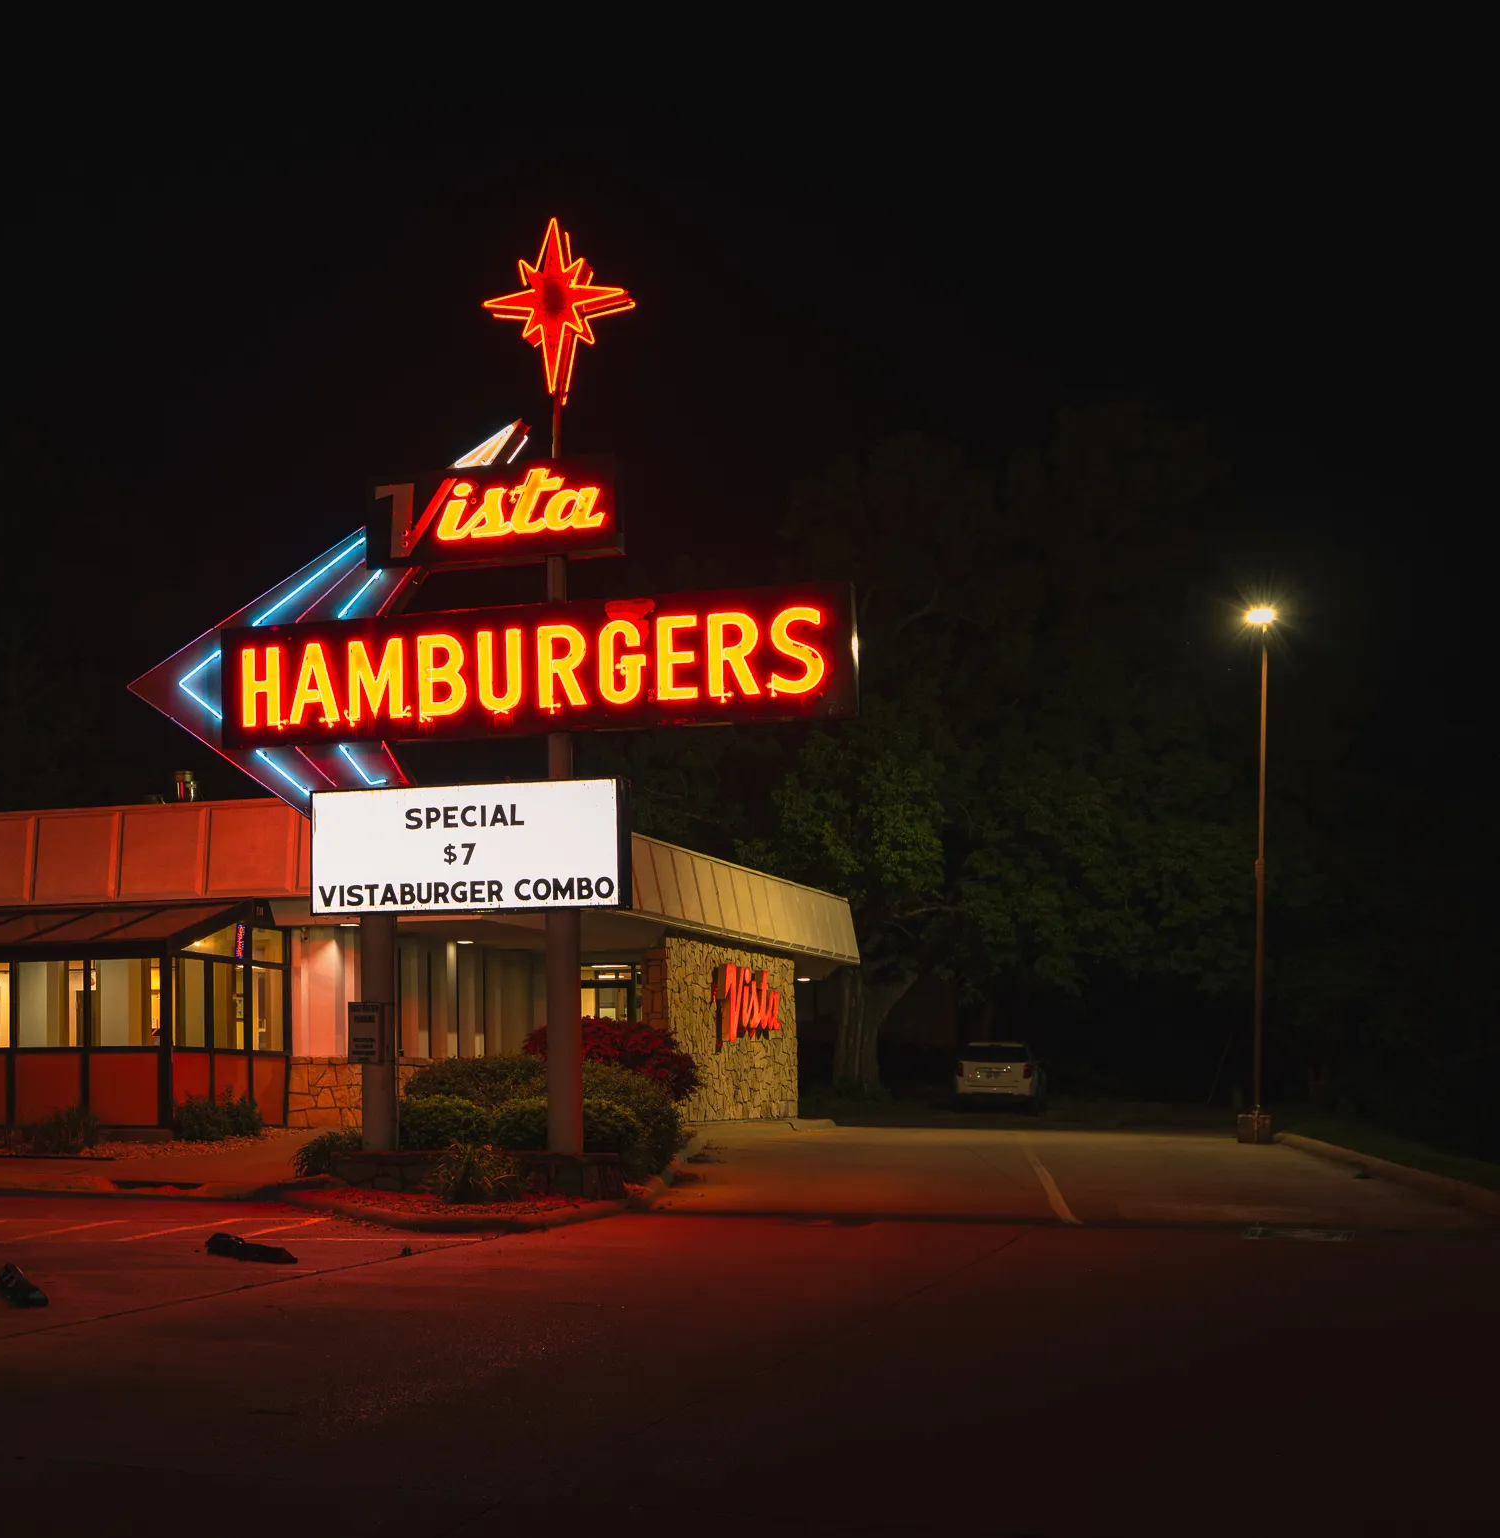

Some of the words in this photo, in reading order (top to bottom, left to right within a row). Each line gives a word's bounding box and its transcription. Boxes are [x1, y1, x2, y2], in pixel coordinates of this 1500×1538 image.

[375, 468, 606, 558] Vista
[241, 606, 825, 729] HAMBURGERS
[405, 804, 524, 829] SPECIAL
[443, 843, 476, 865] $7
[319, 880, 503, 907] VISTABURGER
[514, 876, 614, 902] COMBO
[723, 963, 780, 1042] Vista
